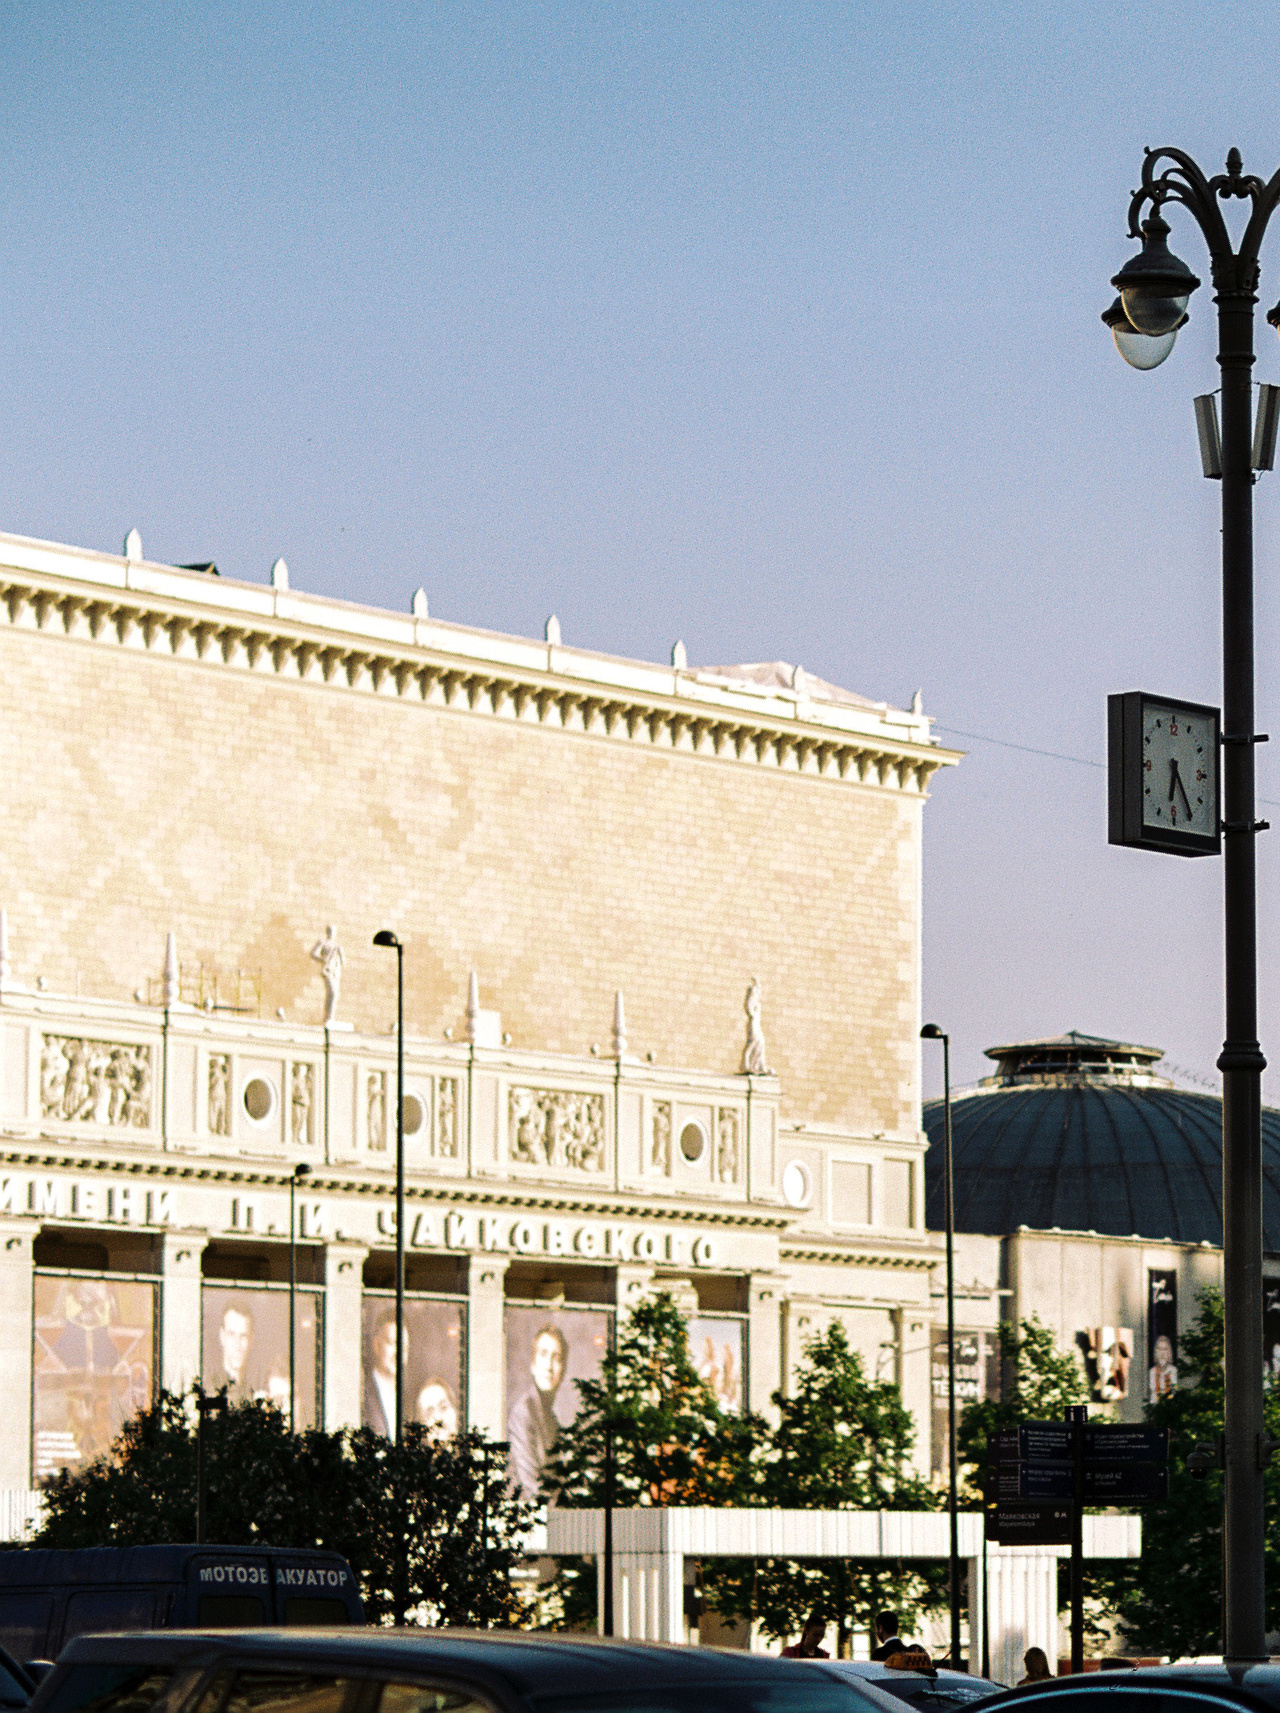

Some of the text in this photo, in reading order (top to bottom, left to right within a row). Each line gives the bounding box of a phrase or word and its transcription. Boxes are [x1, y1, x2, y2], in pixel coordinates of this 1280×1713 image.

[1170, 723, 1179, 737] 12
[1145, 759, 1152, 772] 9
[1195, 769, 1203, 782] 3
[1170, 804, 1177, 818] 6
[376, 1207, 719, 1266] ЧАЙКОВСКОГО
[199, 1566, 348, 1587] МОТОЭВАКУАТОР
